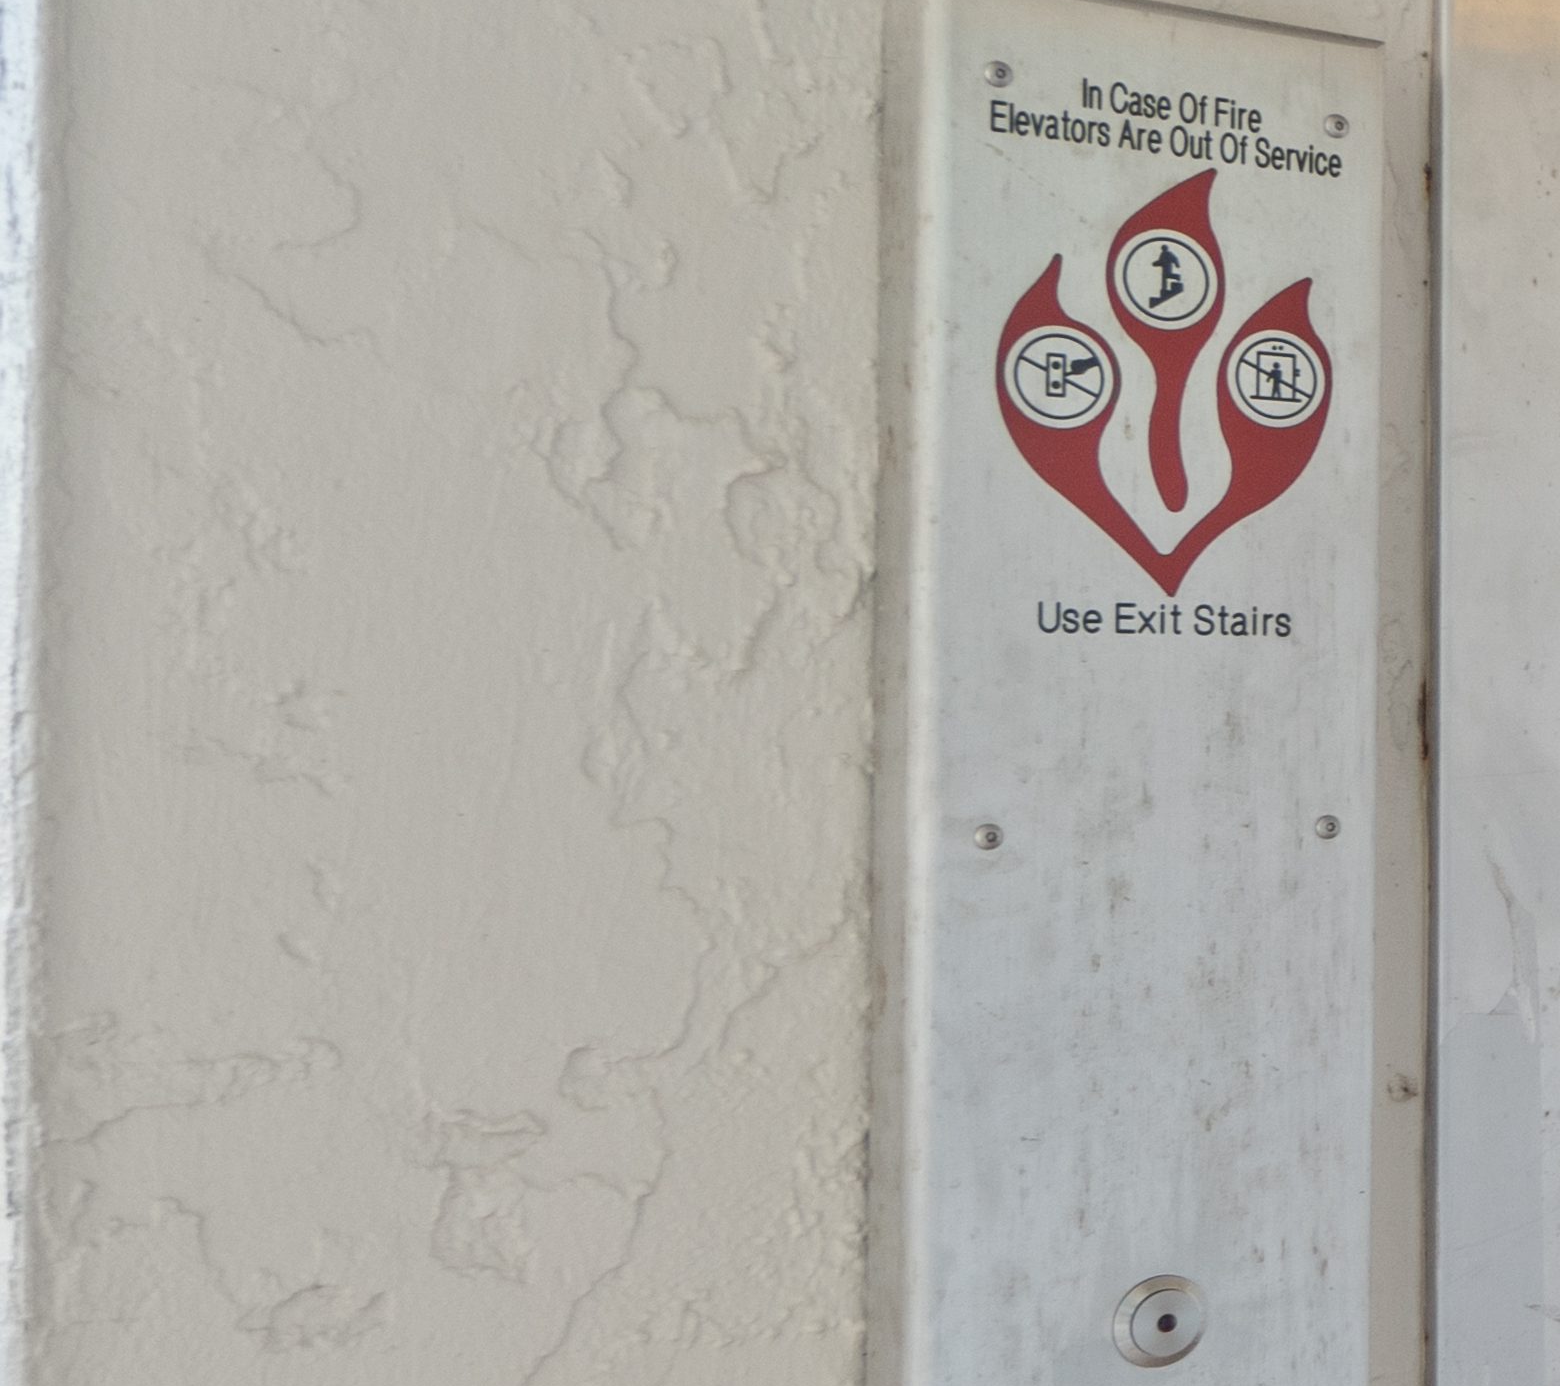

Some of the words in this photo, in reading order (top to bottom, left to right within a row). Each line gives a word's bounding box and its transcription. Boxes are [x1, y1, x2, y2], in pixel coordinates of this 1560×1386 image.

[1081, 77, 1103, 111] In
[1110, 81, 1172, 121] Case
[1178, 91, 1208, 125] Of
[1214, 96, 1262, 134] Fire
[990, 99, 1111, 148] Elevators
[1118, 119, 1163, 155] Are
[1169, 124, 1213, 161] Out
[1219, 132, 1249, 165] Of
[1254, 136, 1343, 178] Service
[1037, 601, 1103, 634] Use
[1115, 602, 1182, 635] Exit
[1193, 603, 1292, 638] Stairs
